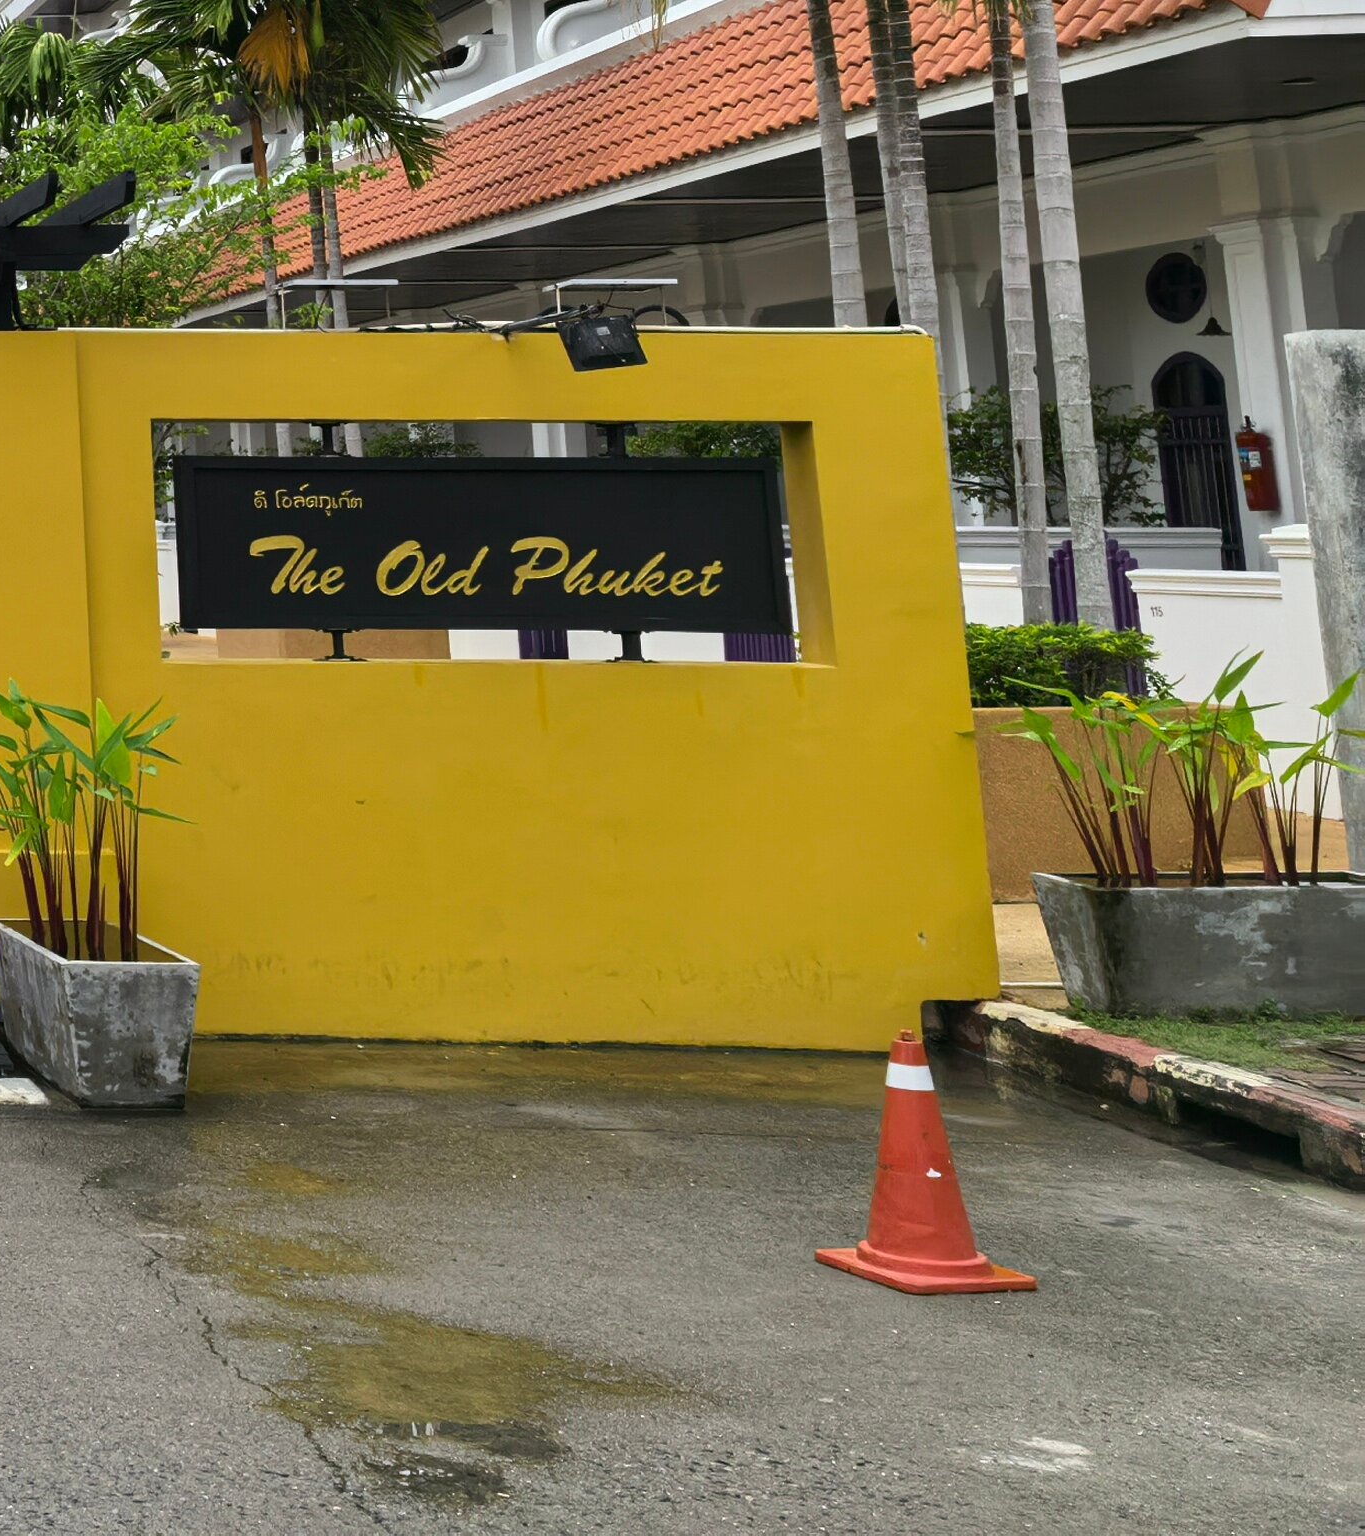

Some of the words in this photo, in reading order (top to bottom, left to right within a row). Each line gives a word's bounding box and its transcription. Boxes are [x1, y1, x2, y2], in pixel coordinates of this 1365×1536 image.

[249, 535, 346, 595] The
[376, 540, 489, 596] Old
[510, 535, 724, 597] Phuket
